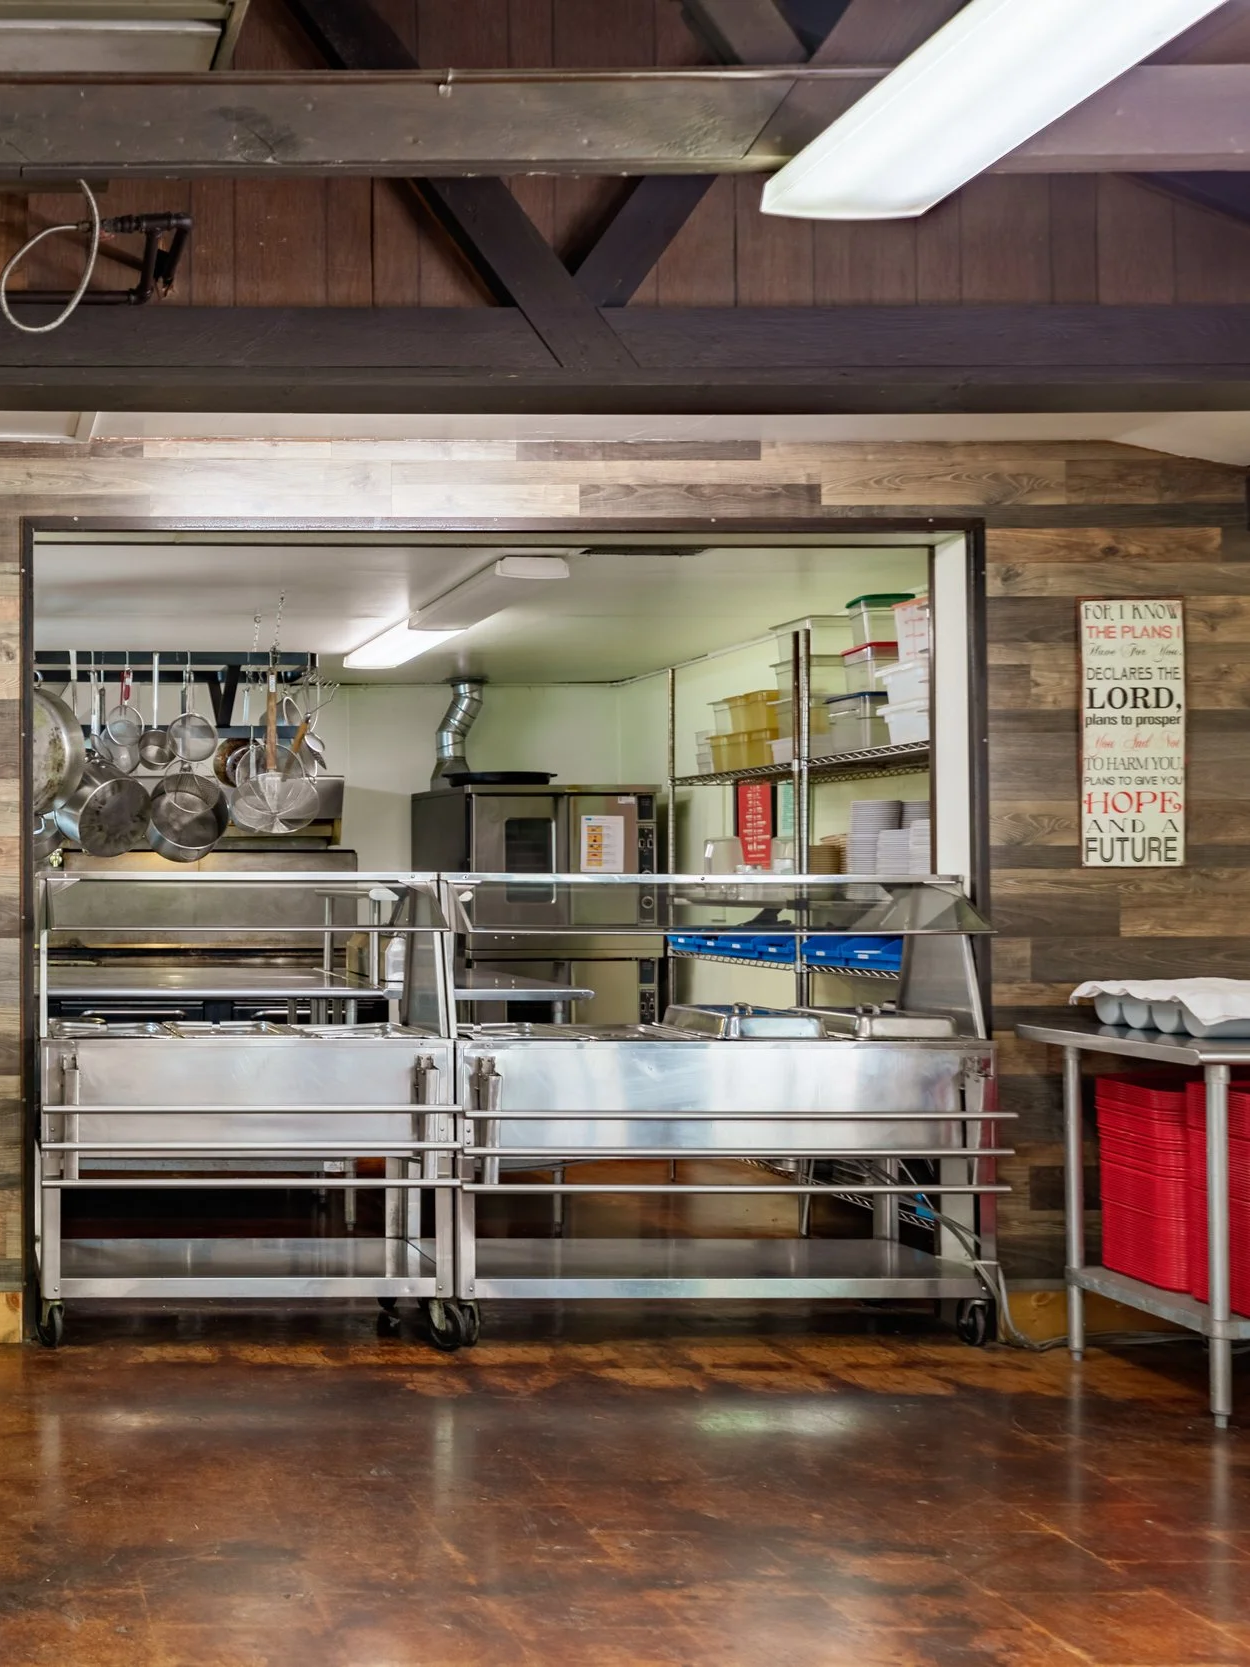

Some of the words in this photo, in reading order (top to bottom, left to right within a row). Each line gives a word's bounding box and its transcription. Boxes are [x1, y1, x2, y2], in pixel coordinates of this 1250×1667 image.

[1084, 604, 1114, 621] FOR
[1119, 604, 1124, 619] I
[1132, 604, 1180, 619] KNOW
[1085, 625, 1117, 639] THE
[1121, 625, 1172, 639] PLANS
[1177, 625, 1181, 639] I
[1087, 643, 1116, 656] Have
[1122, 643, 1147, 657] For
[1086, 666, 1153, 680] DECLARES
[1157, 666, 1181, 680] THE
[1086, 686, 1182, 713] LORD,
[1085, 714, 1118, 728] plans
[1121, 715, 1133, 725] to
[1136, 715, 1182, 728] prosper
[1084, 756, 1104, 771] TO
[1106, 756, 1149, 771] HARM
[1084, 776, 1115, 786] PLANS
[1118, 776, 1132, 786] TO
[1134, 776, 1158, 786] GIVE
[1161, 776, 1183, 786] YOU
[1083, 791, 1182, 814] HOPE
[1086, 818, 1145, 833] AND
[1161, 819, 1180, 833] A
